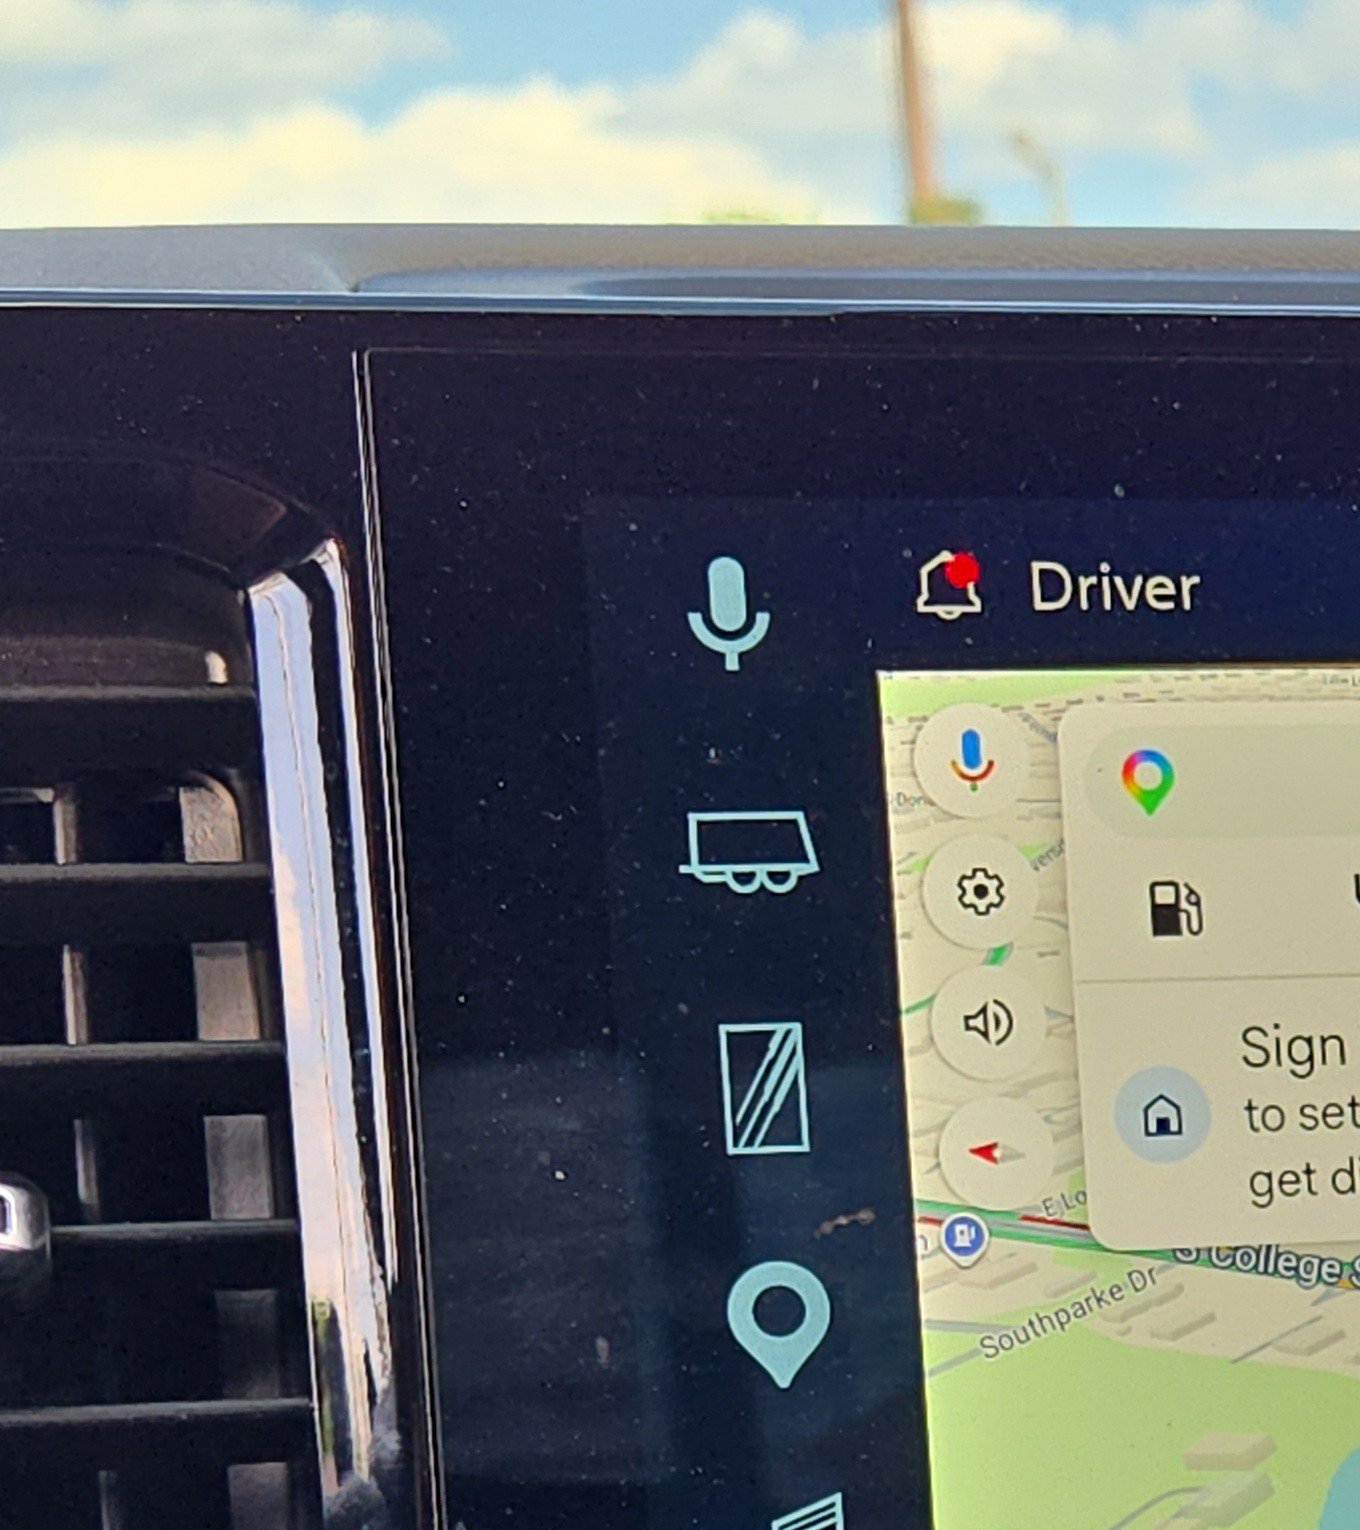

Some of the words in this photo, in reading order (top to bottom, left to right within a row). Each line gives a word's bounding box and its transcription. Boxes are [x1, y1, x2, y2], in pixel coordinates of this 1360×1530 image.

[1030, 560, 1201, 612] Driver
[1242, 1022, 1346, 1079] Sign
[1244, 1098, 1286, 1133] to
[1042, 1197, 1056, 1217] E
[1250, 1162, 1318, 1209] get
[1209, 1243, 1342, 1288] College
[979, 1283, 1125, 1359] Southparke
[1127, 1266, 1159, 1293] Dr
